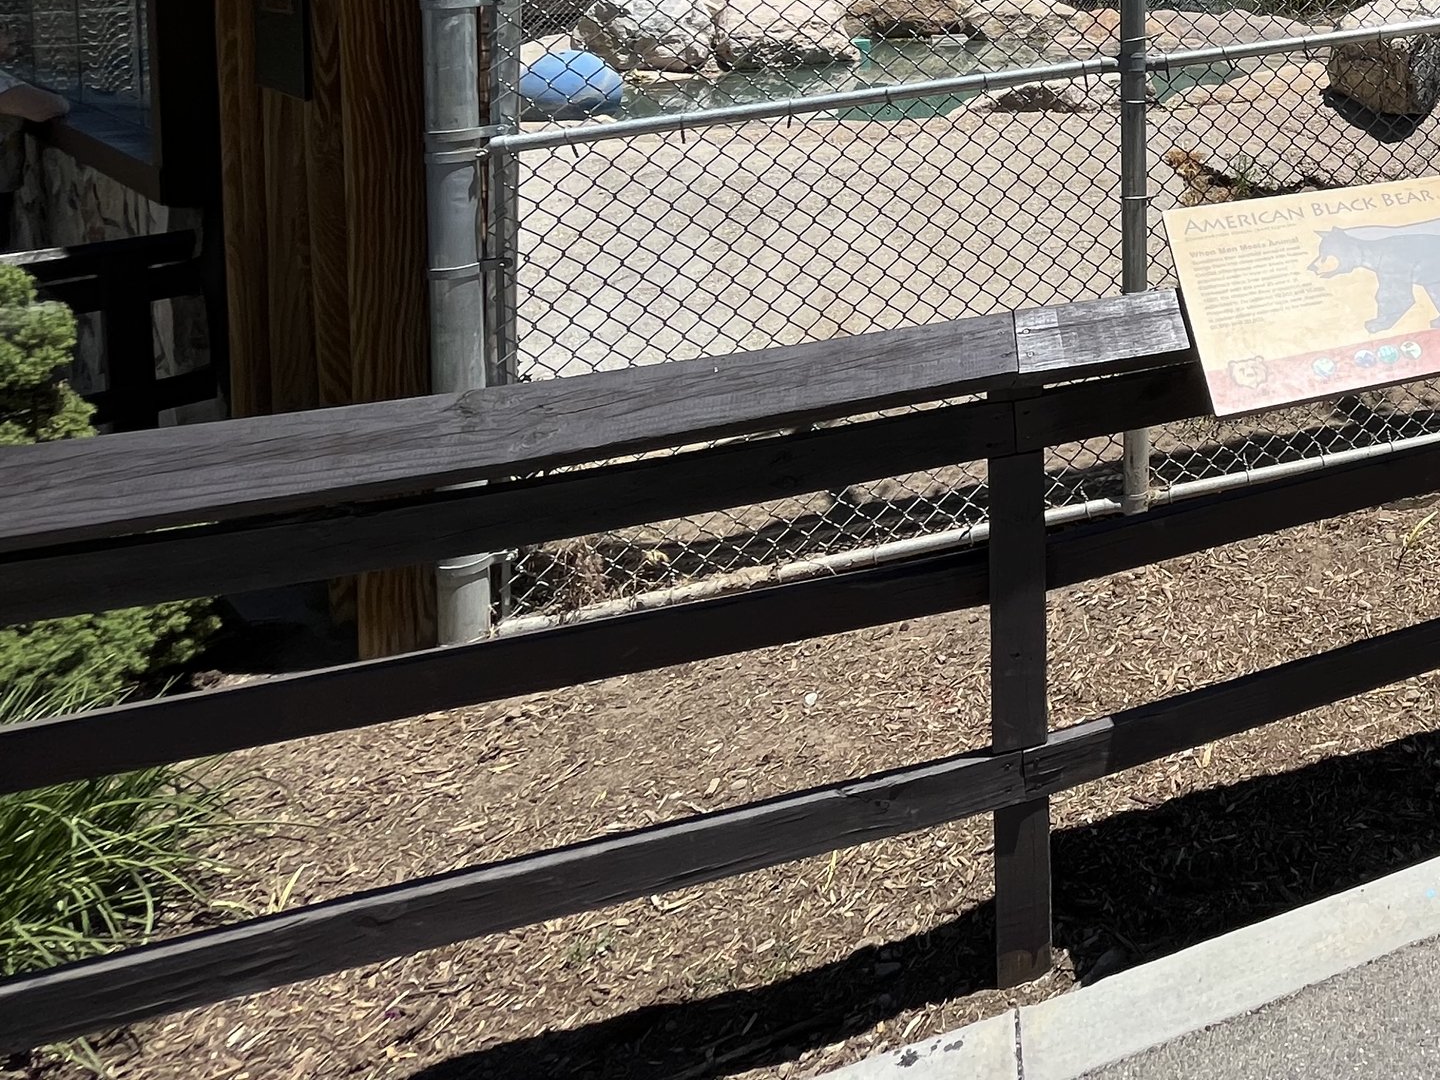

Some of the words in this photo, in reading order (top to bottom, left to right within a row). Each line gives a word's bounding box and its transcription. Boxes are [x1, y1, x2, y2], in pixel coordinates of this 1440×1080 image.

[1184, 206, 1304, 235] AMERICAN
[1311, 196, 1377, 217] BLACK
[1380, 189, 1434, 207] BEAR
